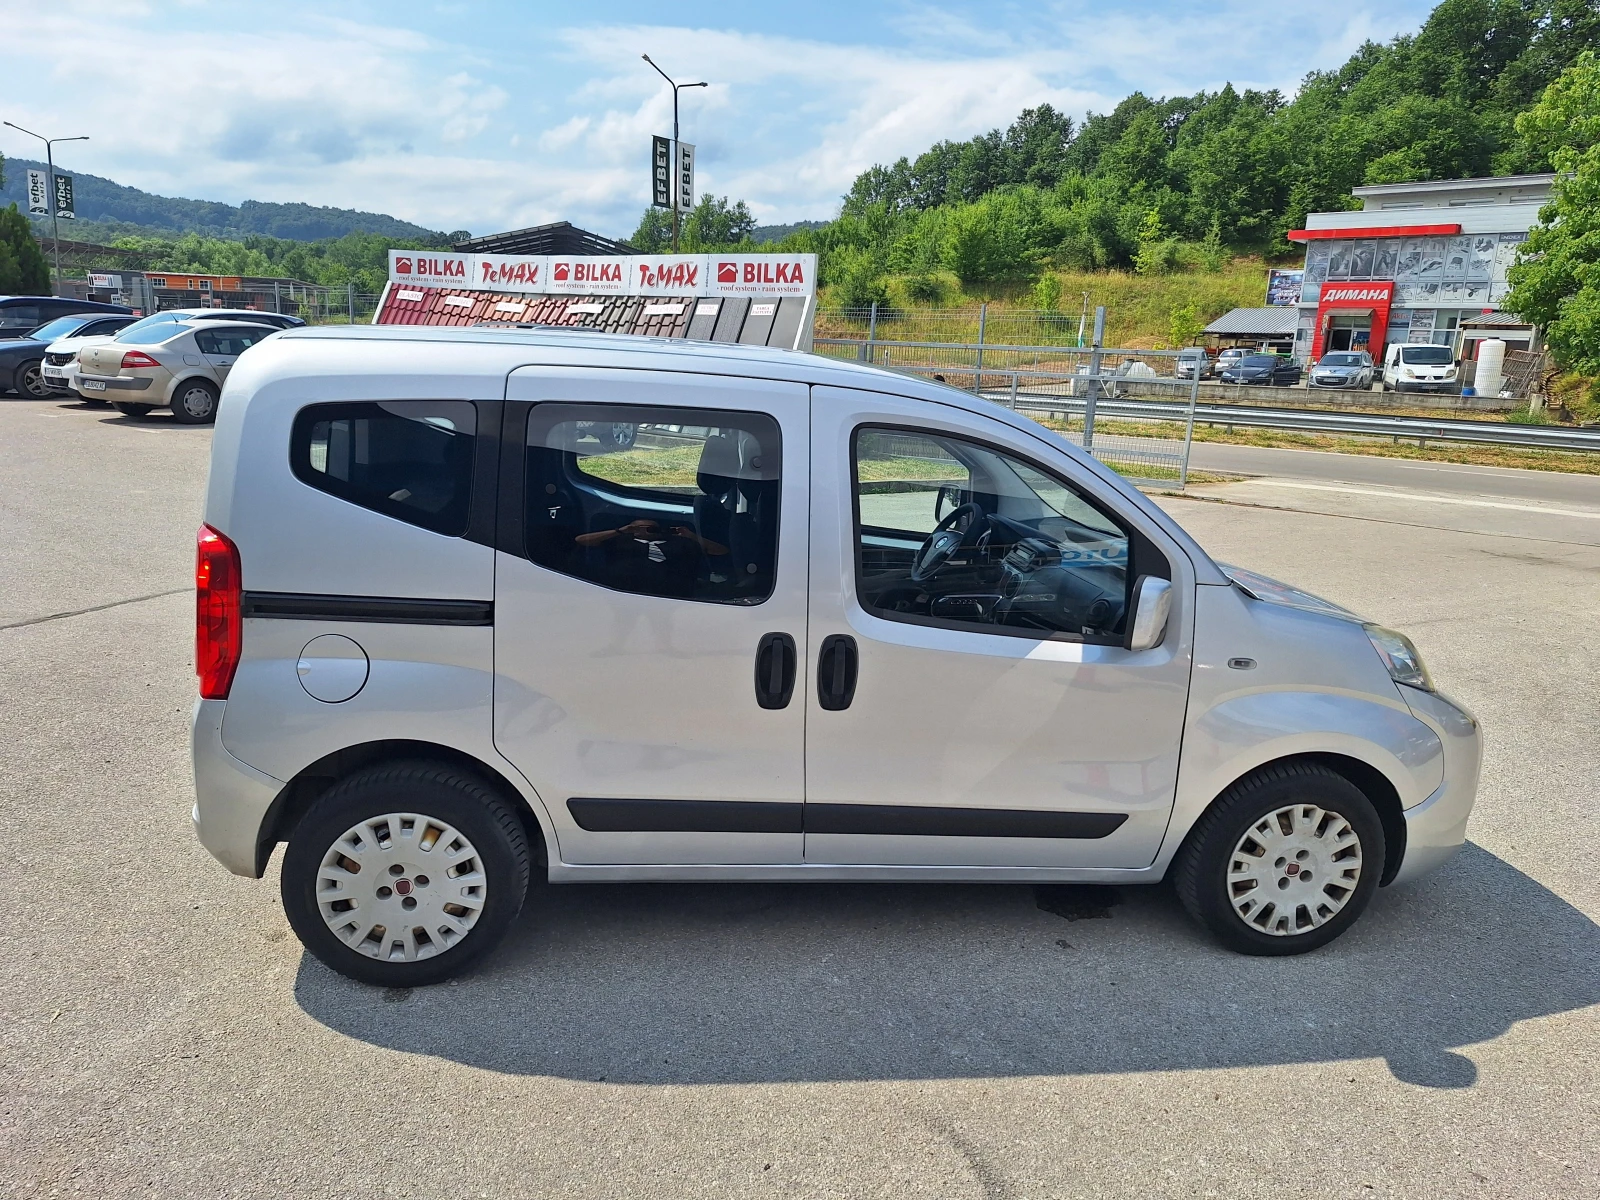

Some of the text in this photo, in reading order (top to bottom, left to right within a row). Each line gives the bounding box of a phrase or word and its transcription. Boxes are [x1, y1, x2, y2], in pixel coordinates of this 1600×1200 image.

[656, 140, 667, 204] EFBET
[682, 147, 691, 208] EFBET
[30, 172, 40, 204] efbet
[57, 177, 67, 208] efbet
[417, 258, 466, 277] BILKA
[481, 261, 539, 285] TeMAX
[574, 263, 622, 282] BILKA
[639, 263, 698, 289] TeMAX
[743, 262, 804, 284] BILKA
[734, 285, 757, 293] system
[776, 286, 800, 294] system
[1322, 289, 1389, 302] ДИМАНА
